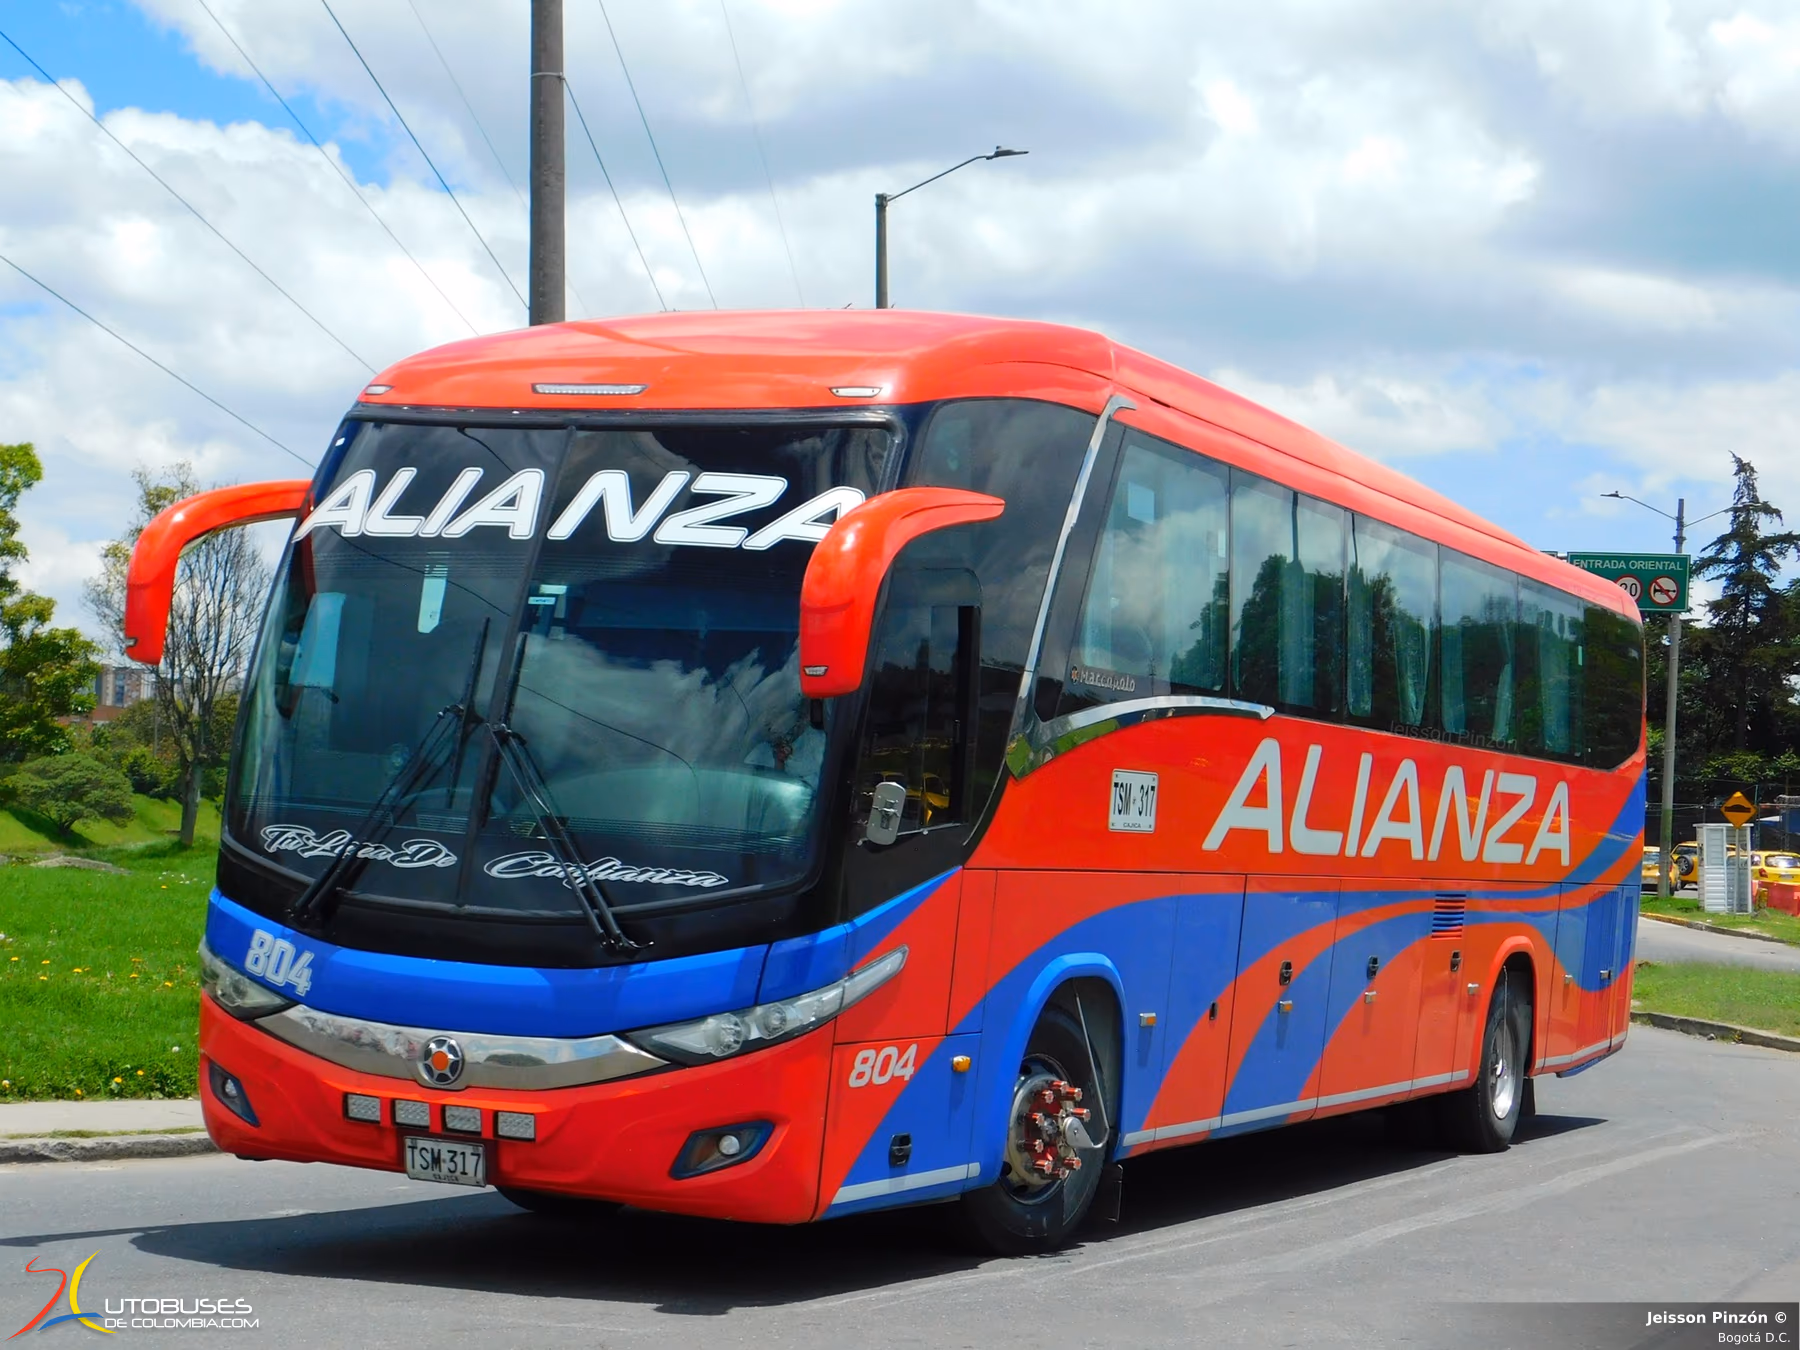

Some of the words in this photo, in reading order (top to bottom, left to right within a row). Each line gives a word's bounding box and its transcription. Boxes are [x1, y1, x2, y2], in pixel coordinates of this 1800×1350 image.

[292, 467, 866, 549] ALIANZA
[1573, 559, 1626, 570] ENTRADA
[1629, 560, 1683, 571] ORIENTAL
[1080, 668, 1136, 692] Marcopolo
[1201, 737, 1571, 867] ALIANZA
[388, 839, 457, 867] De
[244, 928, 315, 997] 804
[848, 1043, 918, 1088] 804
